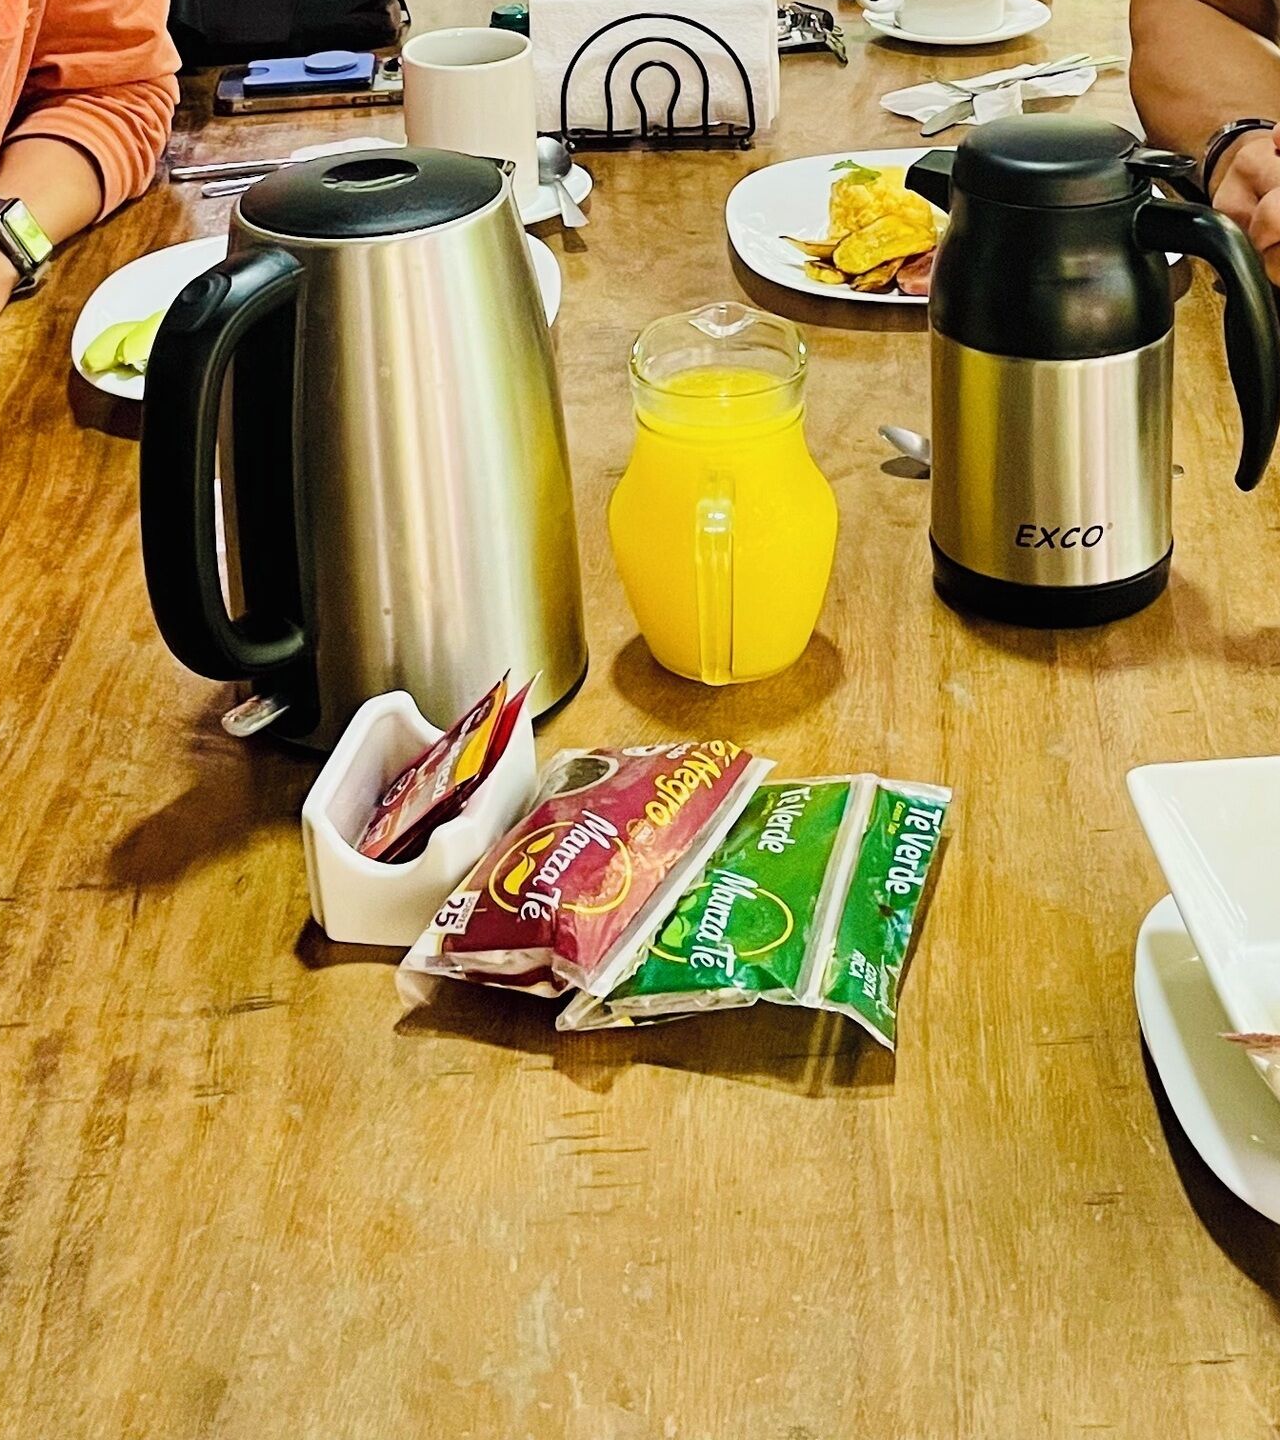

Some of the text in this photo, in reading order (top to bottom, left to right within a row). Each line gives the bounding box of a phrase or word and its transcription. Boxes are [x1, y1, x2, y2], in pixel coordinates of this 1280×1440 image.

[1015, 524, 1104, 549] EXCO
[644, 750, 722, 827] Negro
[757, 803, 805, 854] Verde
[884, 805, 943, 895] Té Verde
[434, 896, 466, 928] 25
